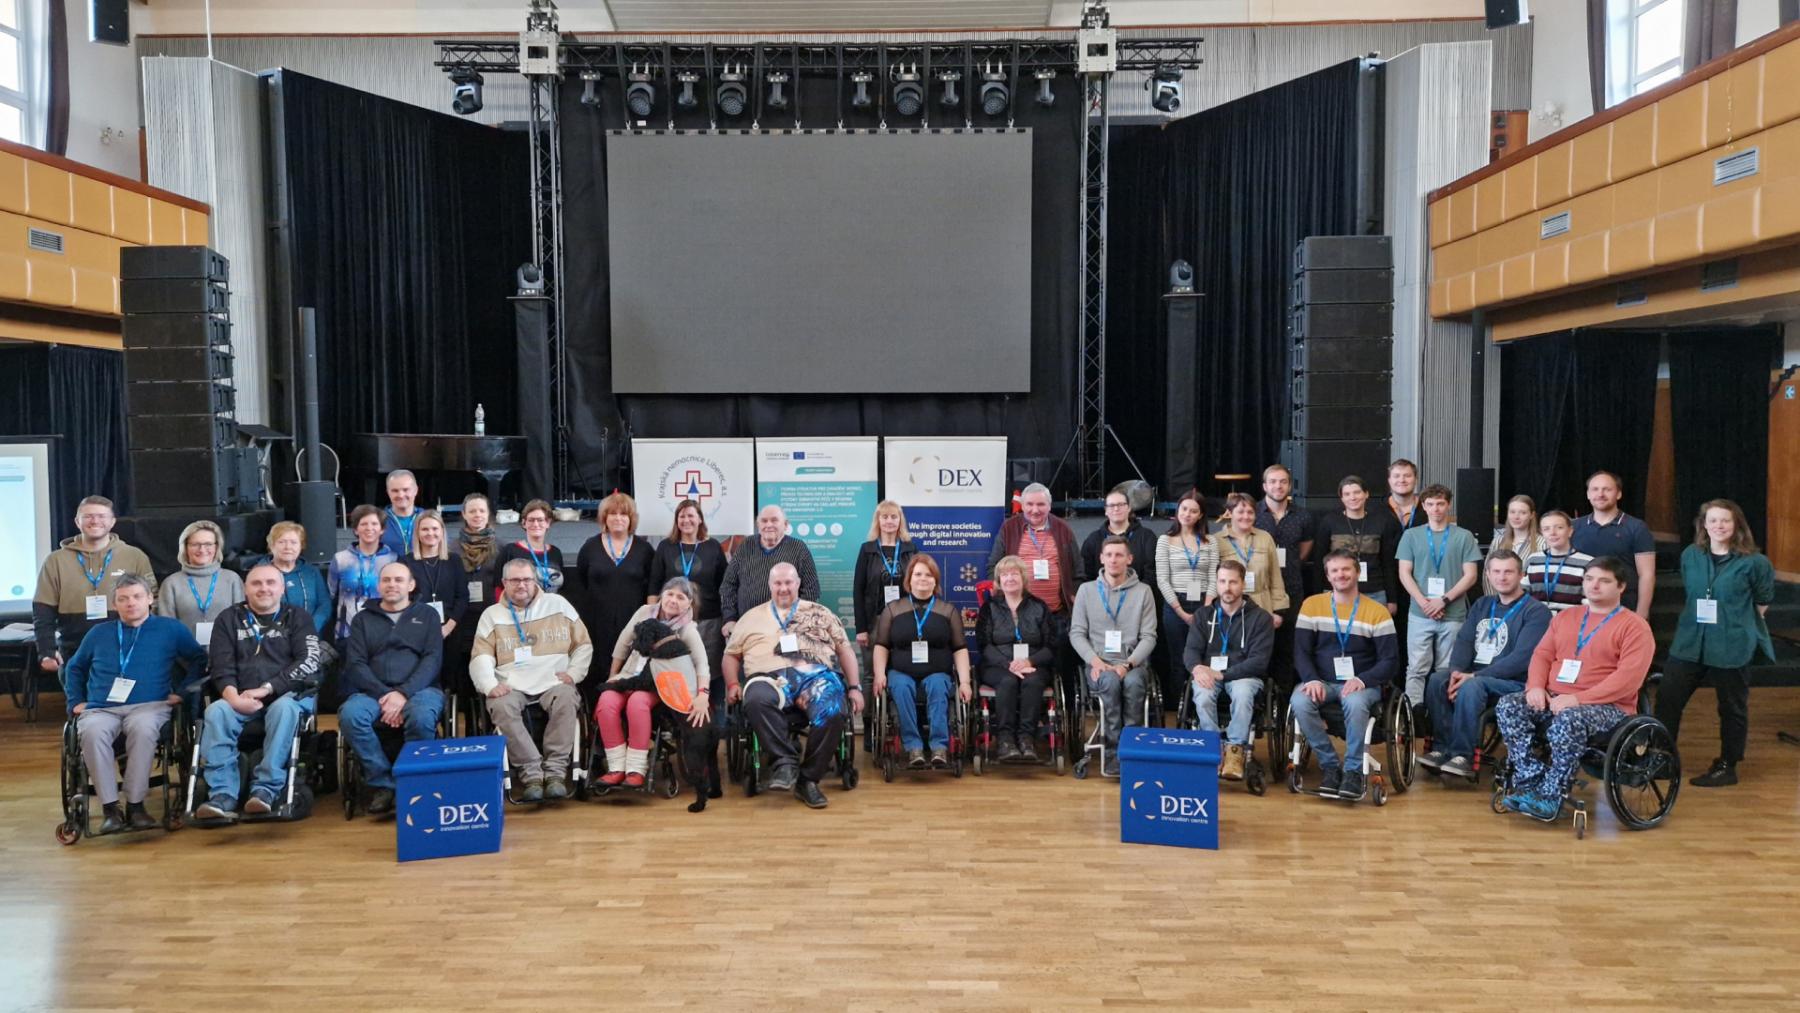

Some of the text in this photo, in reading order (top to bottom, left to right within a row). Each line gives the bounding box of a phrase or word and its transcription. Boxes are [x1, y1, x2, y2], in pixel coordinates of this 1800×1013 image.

[667, 455, 706, 472] nemocnice
[938, 469, 983, 487] DEX
[921, 523, 950, 532] improve
[951, 522, 982, 530] societies
[929, 531, 952, 539] digital
[1163, 737, 1205, 745] DEX
[444, 745, 488, 753] DEX
[1160, 796, 1209, 817] DEX
[439, 803, 489, 825] DEX
